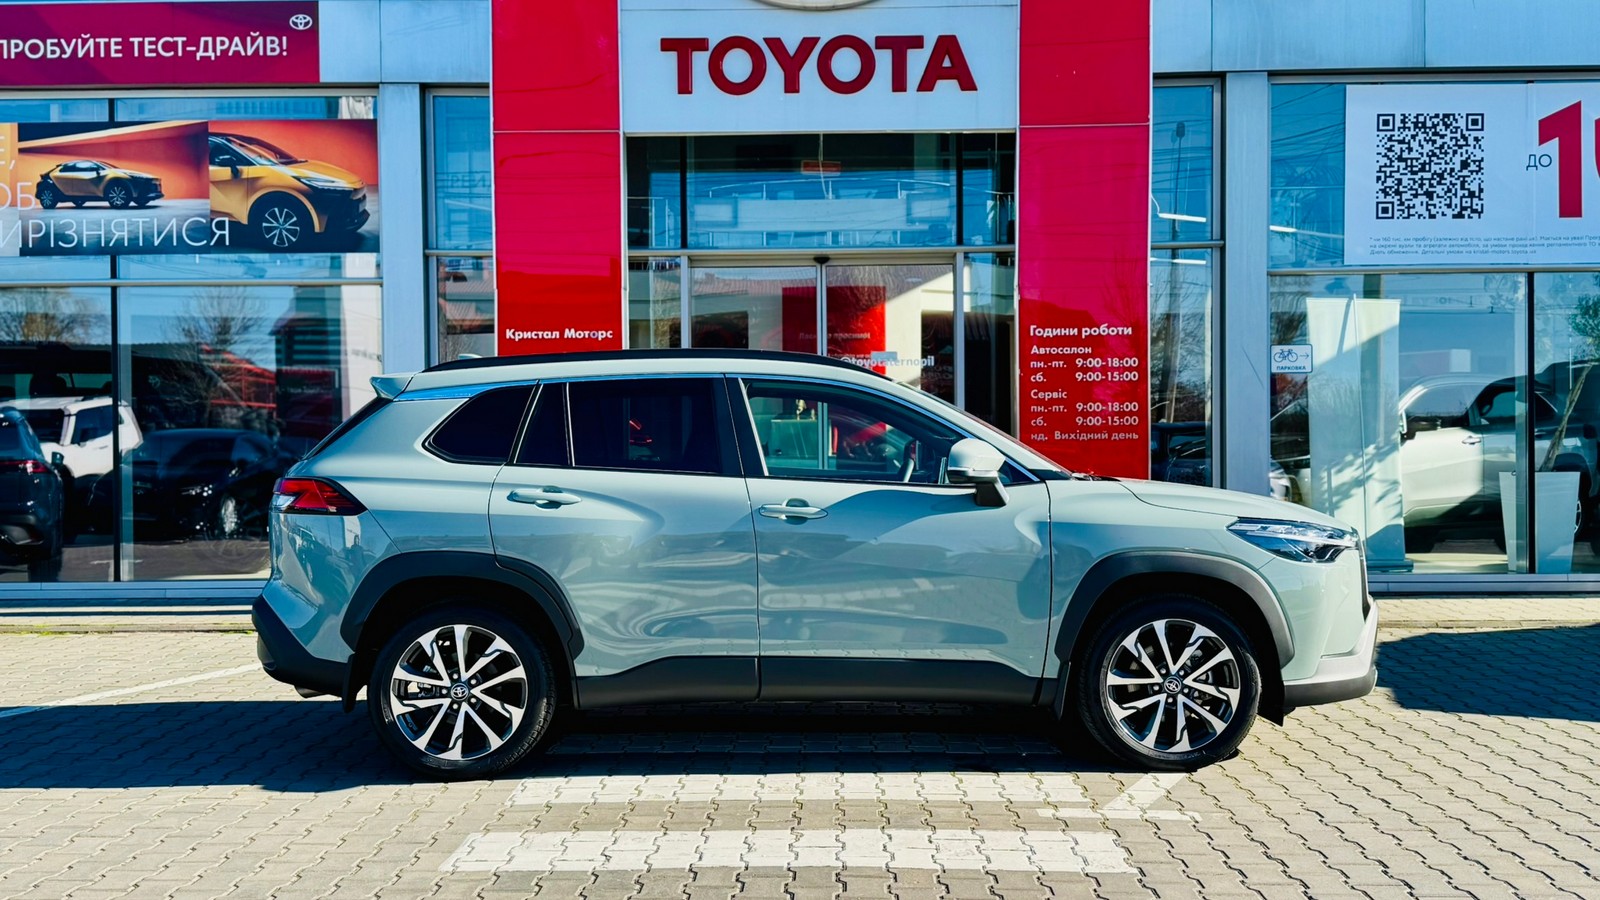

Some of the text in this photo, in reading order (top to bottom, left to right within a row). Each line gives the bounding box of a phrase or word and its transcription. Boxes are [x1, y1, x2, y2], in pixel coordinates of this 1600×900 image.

[129, 31, 288, 61] ТЕСТ-ДРАЙВ!
[660, 34, 978, 96] TOYOTA
[505, 328, 613, 341] Кристал Моторс
[1030, 323, 1132, 339] Години роботи
[1030, 345, 1092, 355] Автосалон
[1075, 358, 1138, 368] 9:00-18:00
[1030, 371, 1138, 382] сб. 9:00-15:00
[1030, 388, 1067, 401] Сервіс
[1075, 402, 1138, 412] 9:00-18:00
[1031, 416, 1138, 426] сб. 9:00-15:00
[1031, 429, 1139, 441] нд. Вихідний день
